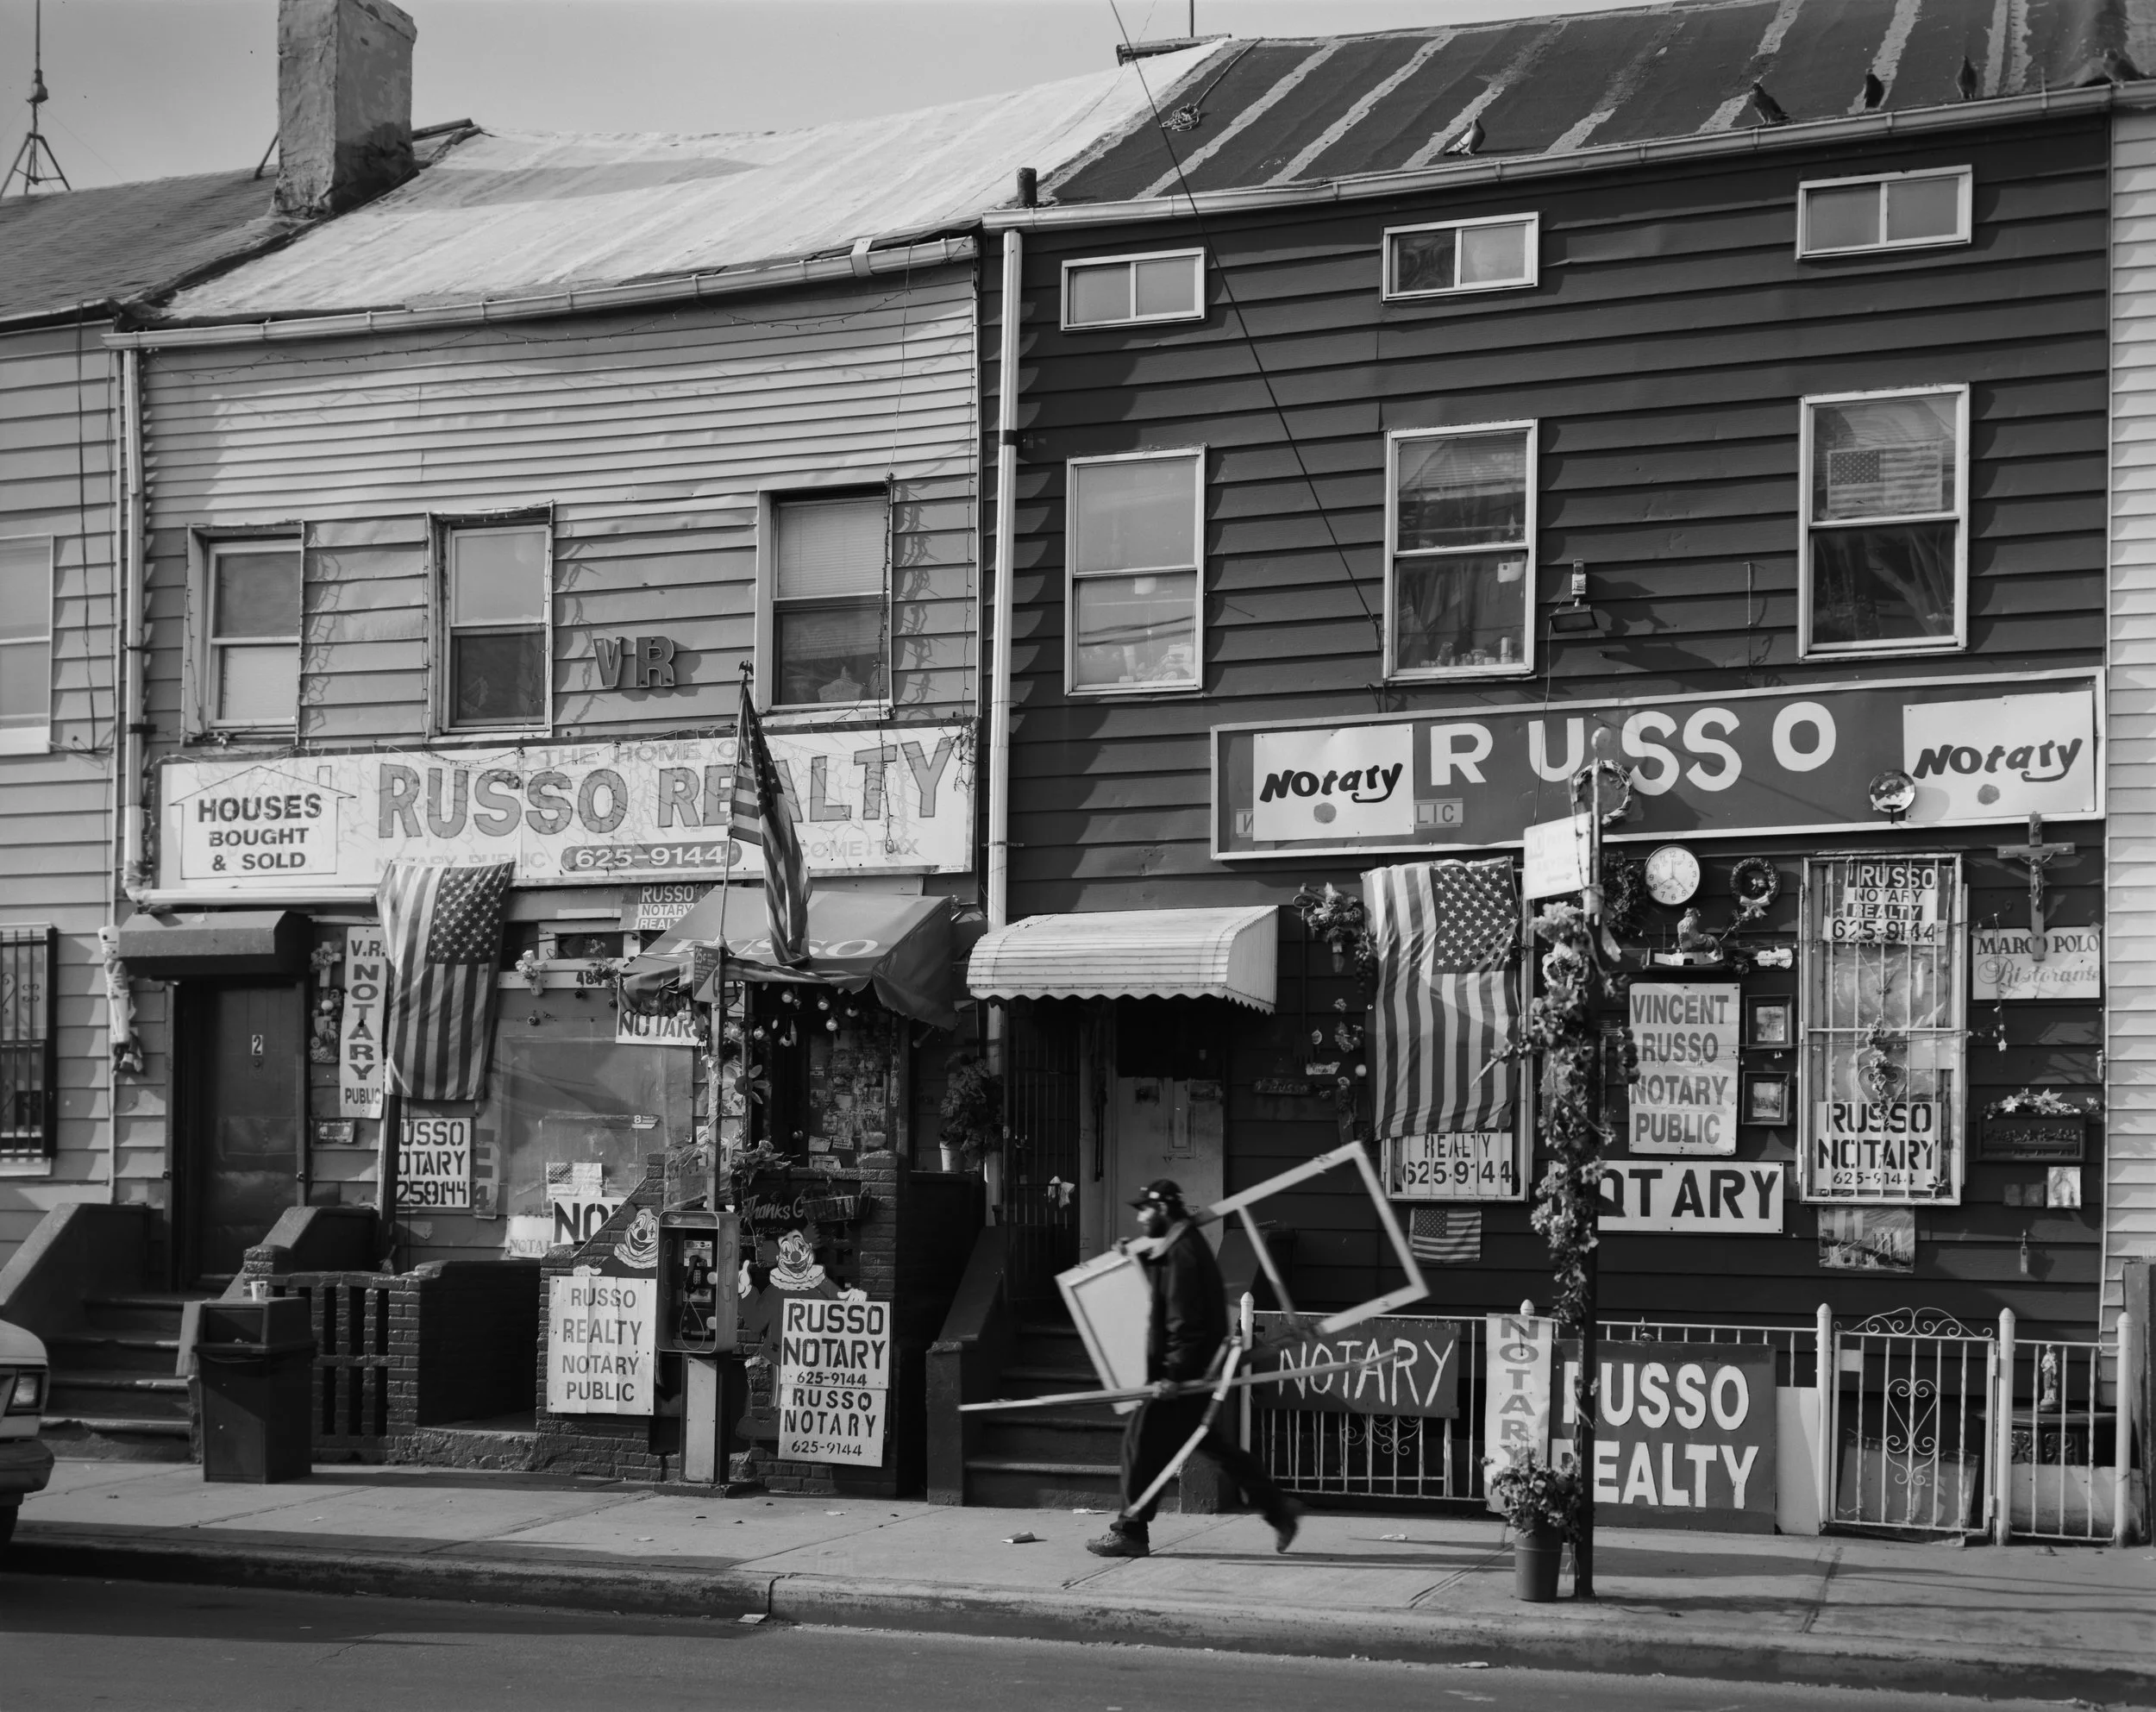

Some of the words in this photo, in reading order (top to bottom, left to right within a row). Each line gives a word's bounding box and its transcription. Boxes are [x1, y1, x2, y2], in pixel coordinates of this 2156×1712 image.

[593, 636, 674, 688] VR
[540, 746, 599, 767] THE
[613, 742, 701, 764] HOME
[1430, 700, 1837, 796] RUSSO
[197, 793, 323, 823] HOUSES
[379, 763, 629, 838] RUSSO
[1415, 804, 1455, 825] LIC
[209, 827, 310, 847] BOUGHT
[799, 840, 862, 858] COME
[211, 855, 227, 872] &
[241, 851, 306, 870] SOLD
[575, 845, 726, 867] 625-9144
[1860, 865, 1936, 889] RUSSO
[641, 885, 694, 903] RUSSO
[640, 918, 681, 930] REAL
[1852, 904, 1921, 920] REALTY
[1832, 919, 1936, 943] 625-9144
[2053, 934, 2099, 953] POLO
[350, 939, 385, 957] V.R.
[1977, 956, 2099, 986] Ristorante
[347, 963, 379, 1081] NOTARY
[1632, 994, 1729, 1025] VINCENT
[618, 1012, 693, 1038] NOTAR
[253, 1035, 261, 1054] 2
[1641, 1032, 1719, 1063] RUSSO
[345, 1087, 381, 1105] PUBLIC
[1631, 1075, 1728, 1107] NOTARY
[1635, 1113, 1720, 1144] PUBLIC
[1827, 1102, 1932, 1133] RUSSO
[400, 1120, 465, 1146] USSO
[1425, 1134, 1491, 1158] REALTY
[1818, 1138, 1940, 1170] NOTARY
[398, 1151, 466, 1176] OTARY
[397, 1181, 467, 1205] 259144
[1598, 1168, 1779, 1220] OTARY
[741, 1194, 791, 1220] Thanks
[570, 1287, 636, 1309] RUSSO
[562, 1318, 642, 1345] REALTY
[787, 1302, 884, 1336] RUSSO
[561, 1354, 640, 1376] NOTARY
[782, 1337, 887, 1370] NOTARY
[796, 1371, 868, 1387] 625-9144
[1277, 1338, 1455, 1408] NOTARY
[566, 1381, 635, 1402] PUBLIC
[792, 1388, 873, 1412] RUSSO
[1499, 1317, 1539, 1465] NOTARY
[783, 1409, 877, 1439] NOTARY
[791, 1439, 863, 1458] 625-9144
